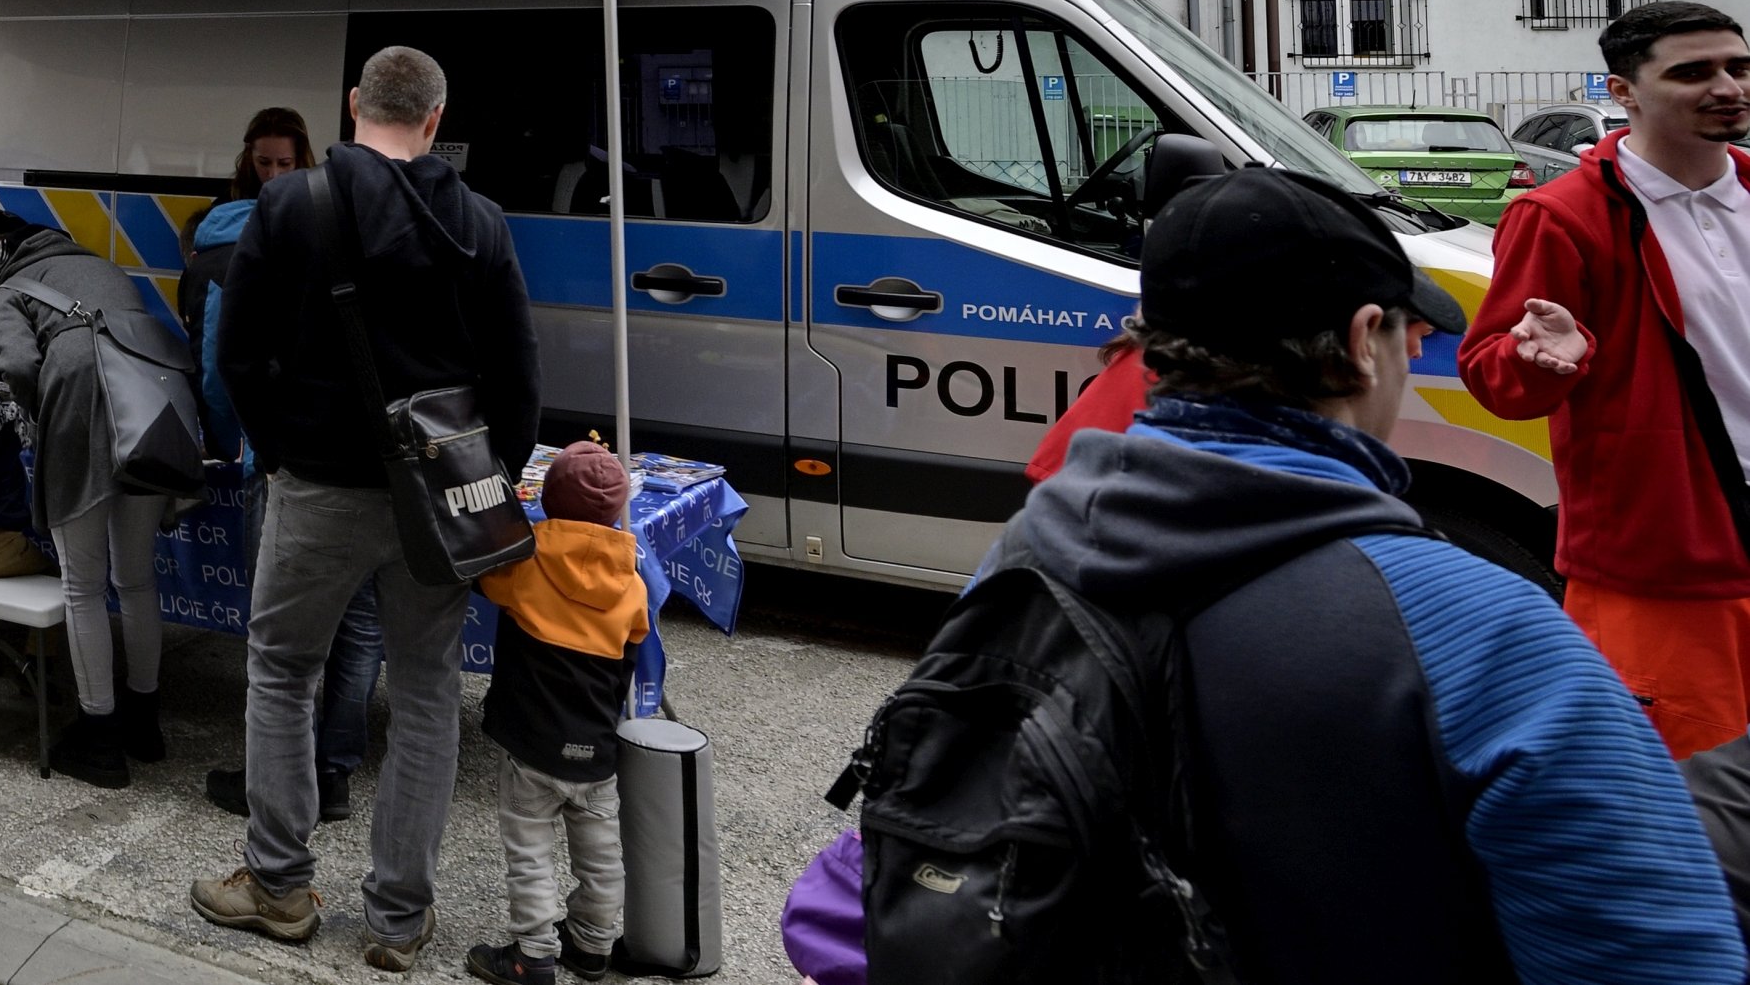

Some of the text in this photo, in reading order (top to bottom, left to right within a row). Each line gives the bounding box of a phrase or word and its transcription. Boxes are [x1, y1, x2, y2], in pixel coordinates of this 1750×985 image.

[1049, 77, 1058, 88] P
[1339, 73, 1349, 84] P
[1593, 75, 1605, 86] P
[1409, 172, 1429, 182] 7AY
[962, 303, 1088, 329] POMÁHAT
[1093, 313, 1114, 330] A
[886, 353, 1100, 425] POLI
[445, 474, 507, 517] PUMA
[197, 522, 229, 546] ČR
[211, 601, 243, 627] ČR
